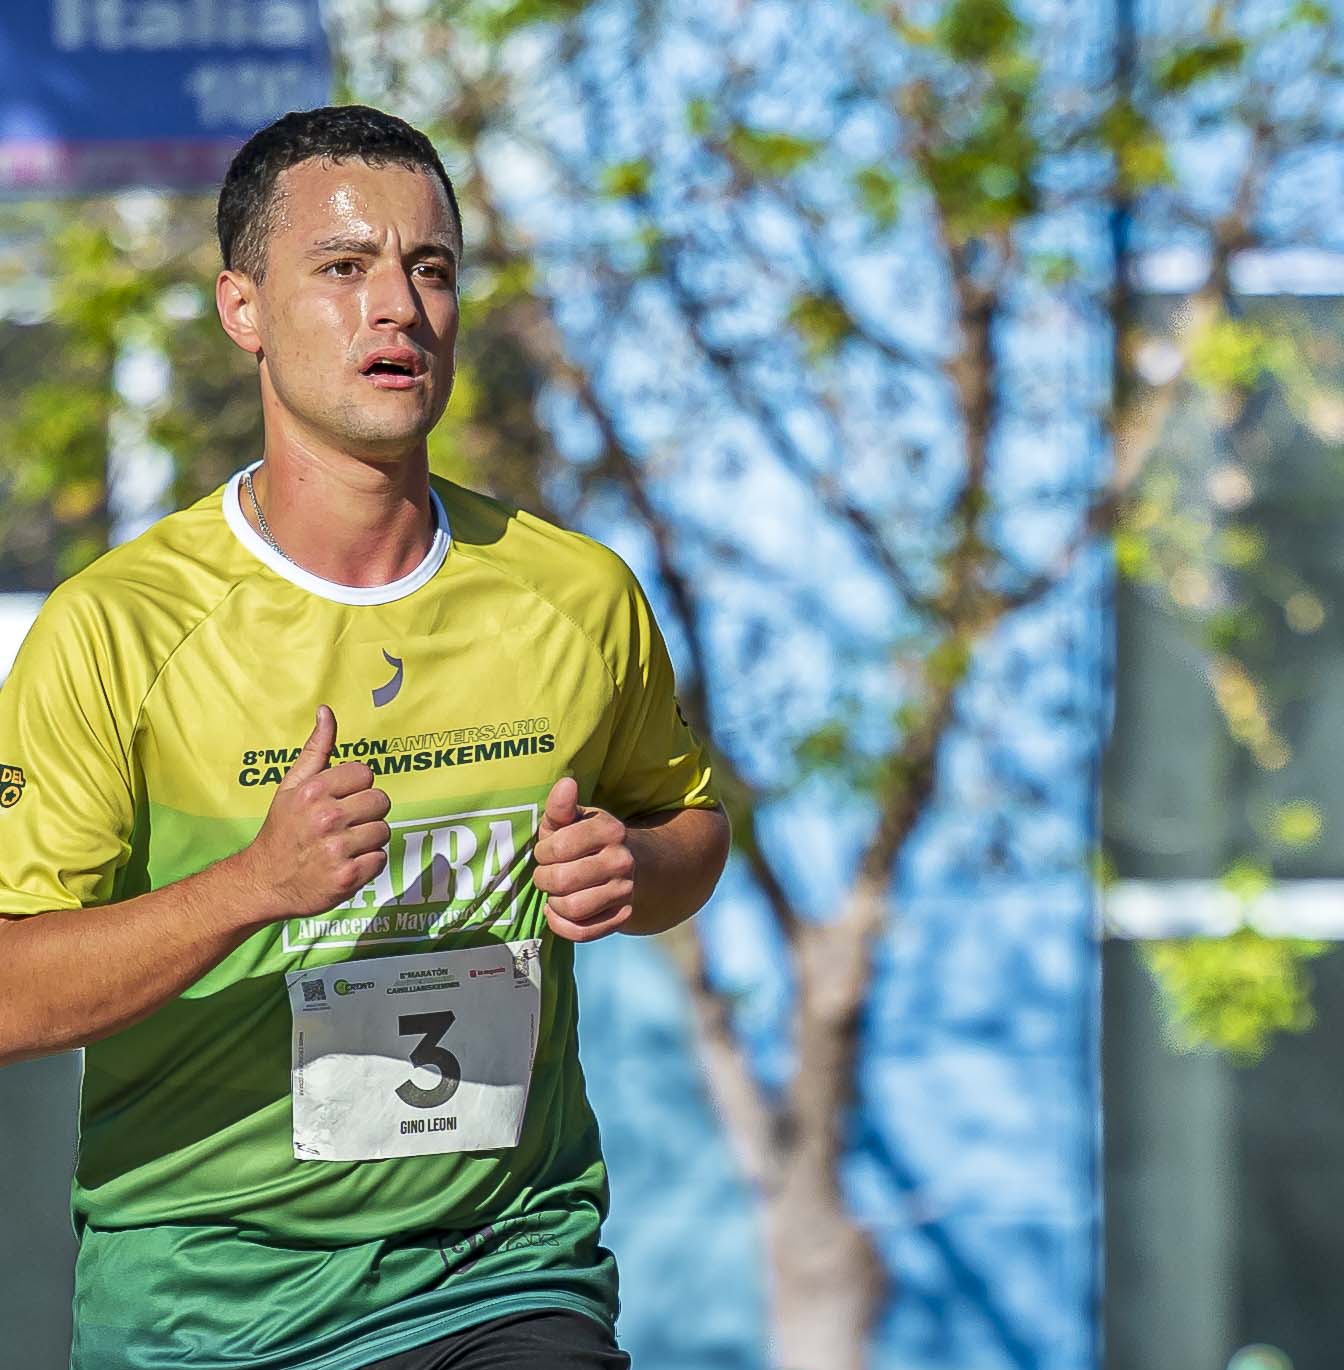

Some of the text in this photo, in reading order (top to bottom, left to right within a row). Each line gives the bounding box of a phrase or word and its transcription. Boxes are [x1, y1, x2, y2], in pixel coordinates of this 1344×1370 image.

[1, 768, 23, 785] DEL
[298, 914, 390, 940] Almacenes
[395, 1010, 461, 1109] 3
[400, 1117, 457, 1135] GINO LEONI
